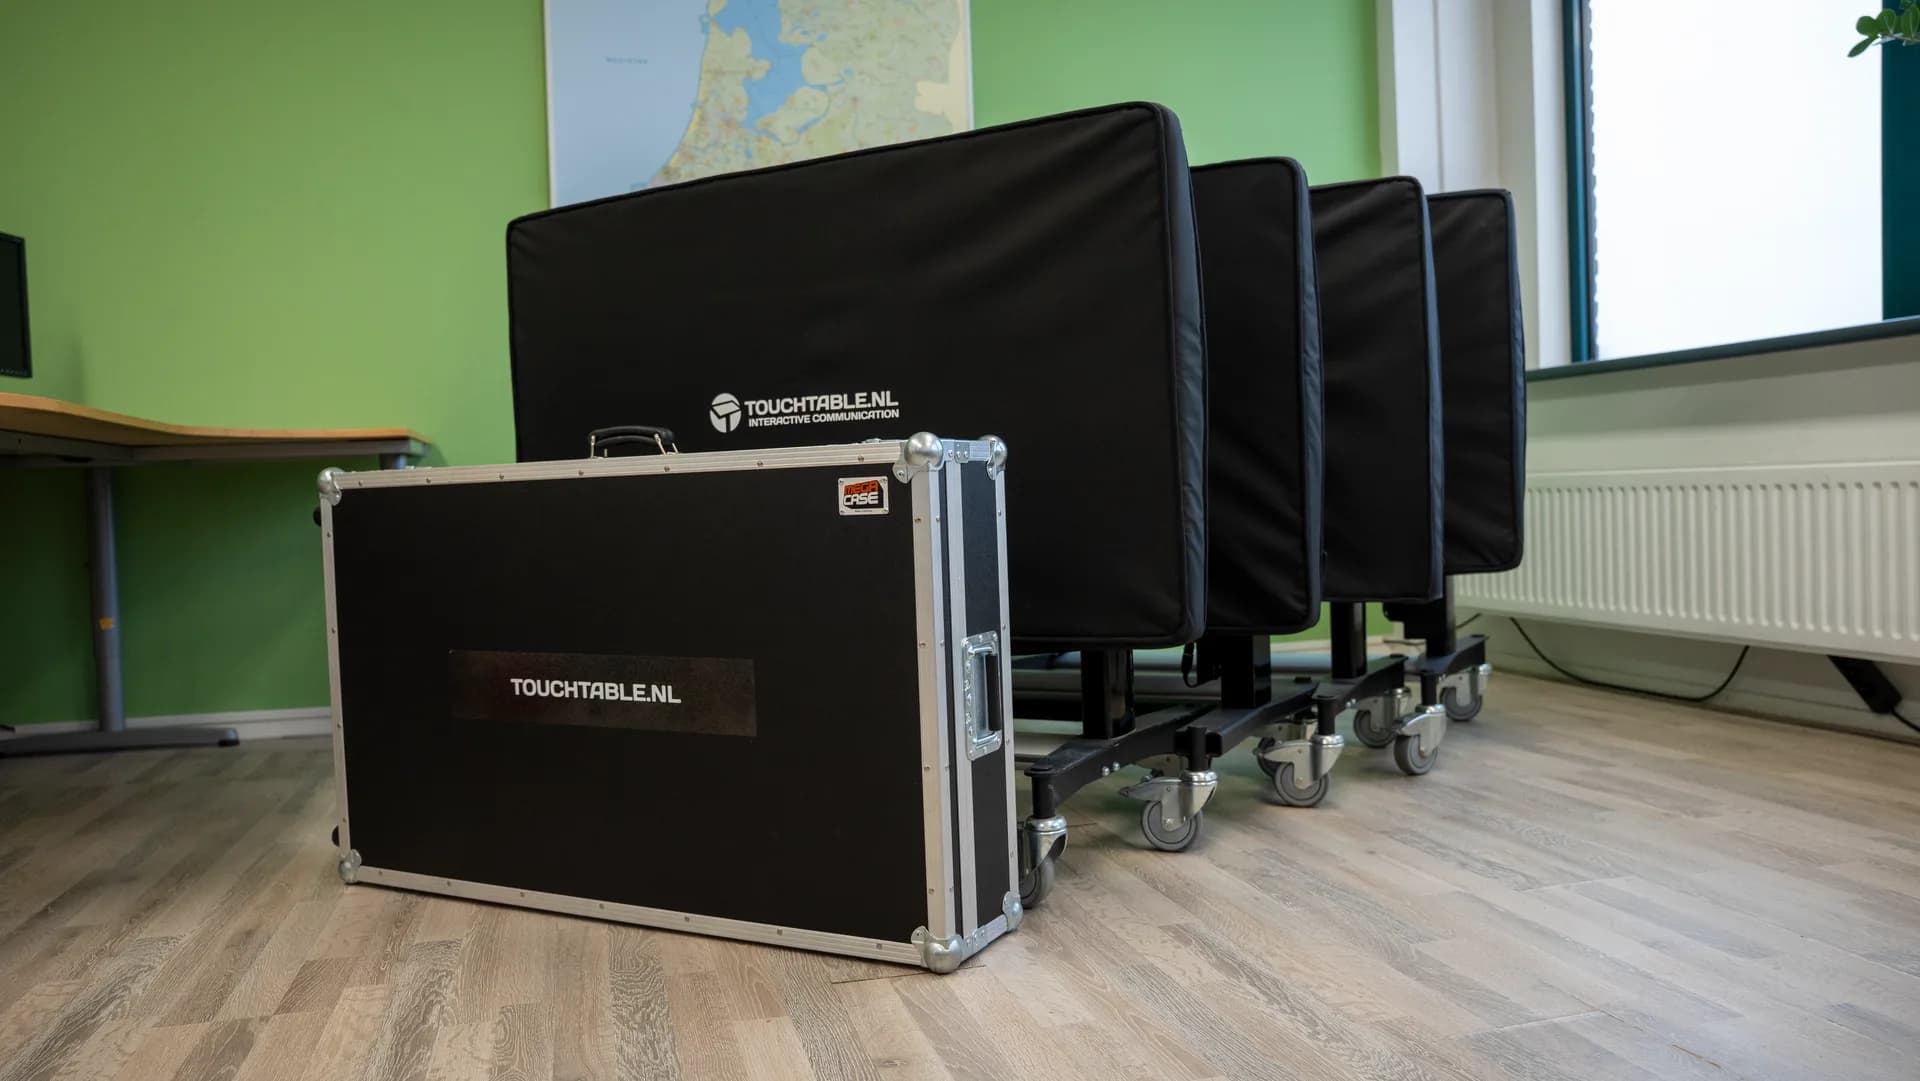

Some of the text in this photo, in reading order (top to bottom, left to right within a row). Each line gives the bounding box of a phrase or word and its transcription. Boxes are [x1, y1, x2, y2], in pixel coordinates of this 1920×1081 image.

[744, 390, 899, 416] TOUCHTABLE.NL
[748, 408, 900, 427] INTERACTIVE COMMUNICATION
[844, 480, 879, 495] MEGA
[844, 491, 879, 505] CASE
[510, 678, 682, 704] TOUCHTABLE.NL
